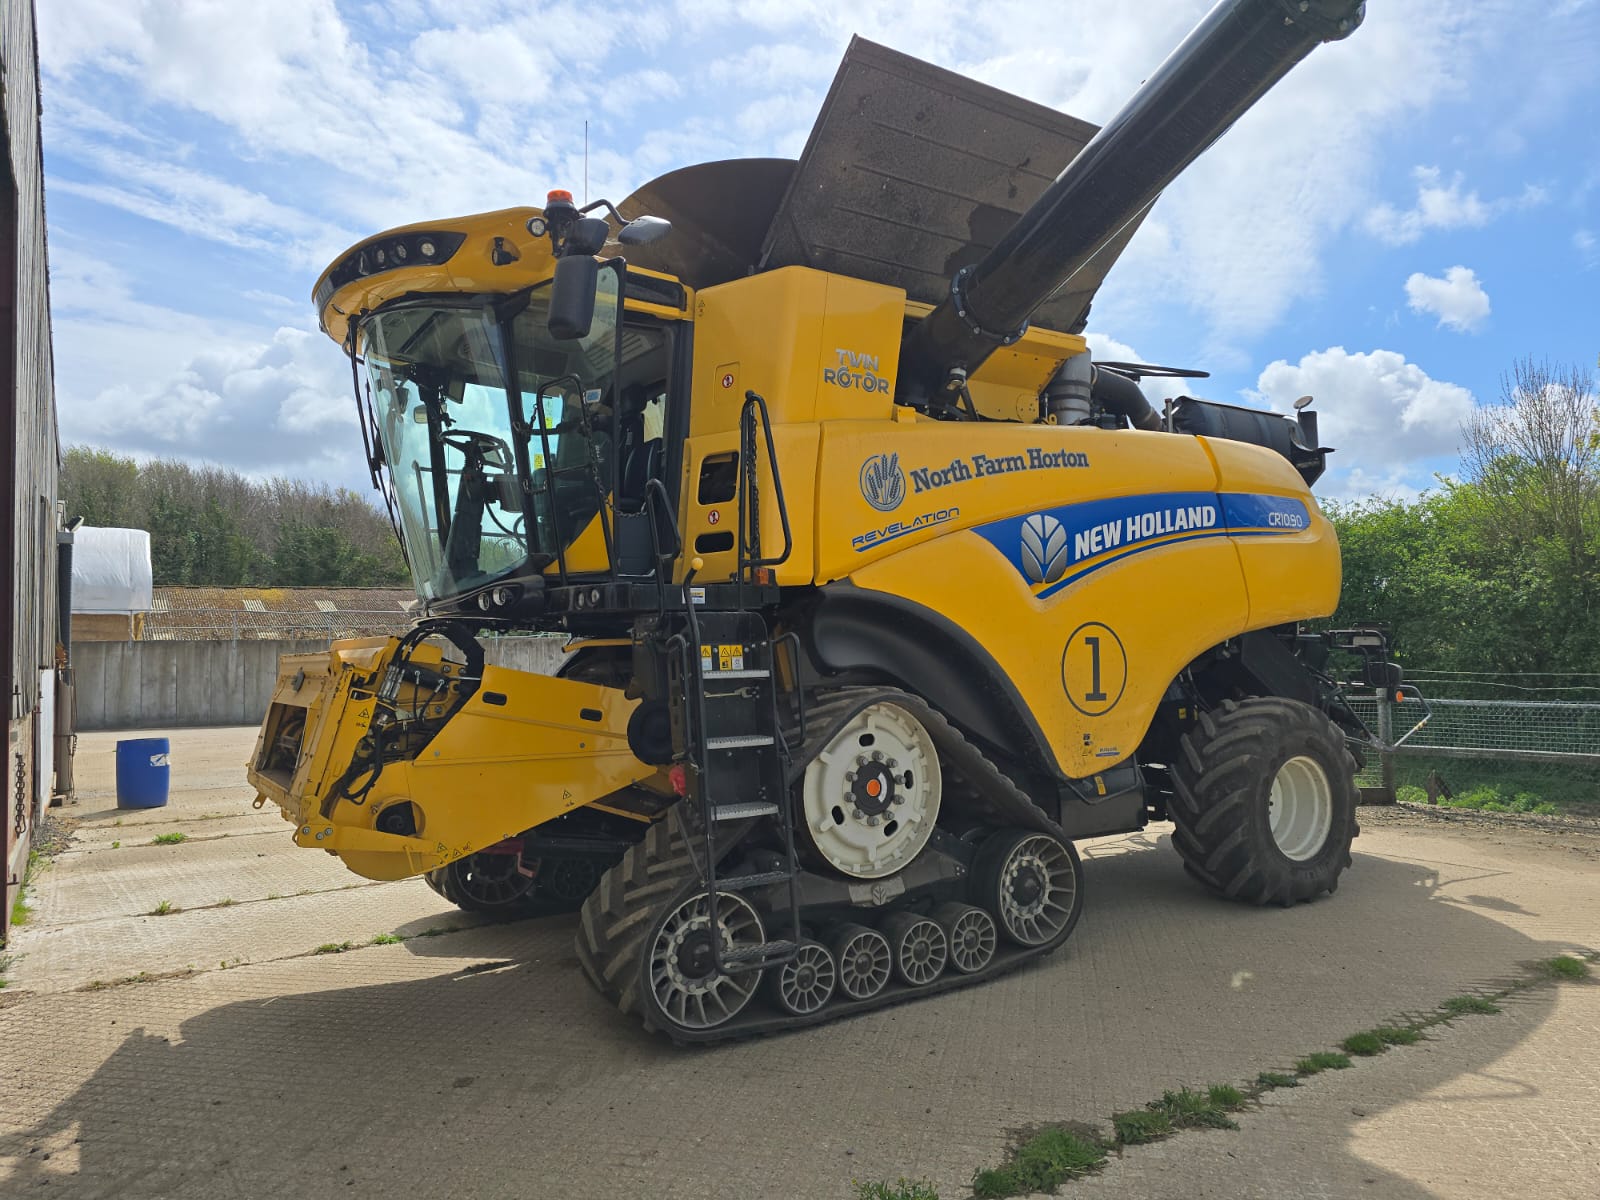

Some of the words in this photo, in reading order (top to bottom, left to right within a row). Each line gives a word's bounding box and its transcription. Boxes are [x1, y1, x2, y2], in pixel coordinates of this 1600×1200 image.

[824, 367, 889, 394] ROTOR
[835, 348, 879, 371] TWIN
[910, 459, 972, 493] North
[972, 454, 1024, 477] Farm
[1026, 448, 1089, 469] Horton
[852, 507, 960, 547] REVELATION
[1074, 519, 1122, 560] NEW
[1126, 505, 1216, 541] HOLLAND
[1084, 636, 1107, 702] 1
